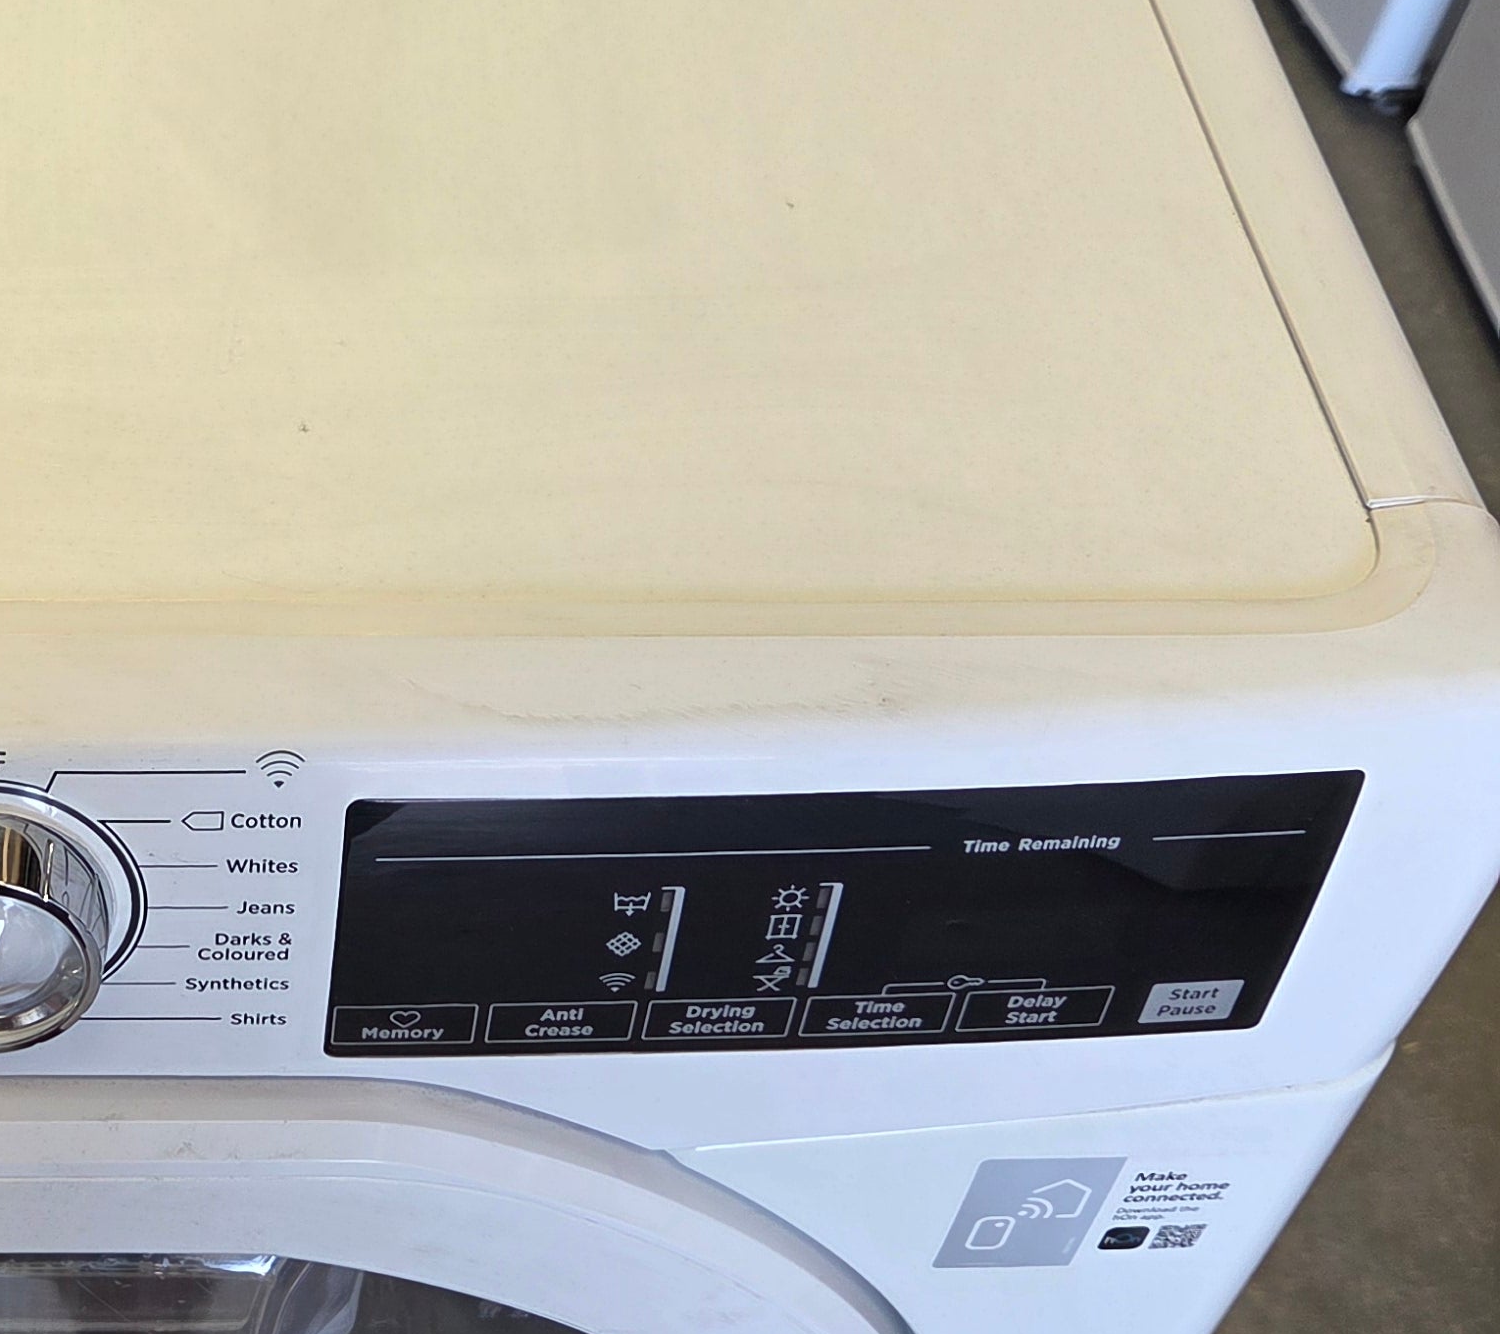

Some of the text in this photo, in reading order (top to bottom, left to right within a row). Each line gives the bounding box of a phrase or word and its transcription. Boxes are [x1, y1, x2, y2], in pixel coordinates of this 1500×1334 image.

[230, 813, 302, 829] Cotton
[963, 835, 1121, 853] Time Remaining
[226, 858, 299, 874] Whites
[236, 900, 296, 915] Jeans
[215, 932, 293, 946] Darks &
[198, 947, 290, 961] Coloured
[185, 977, 289, 992] Synthetics
[1168, 987, 1220, 1001] Start
[854, 1000, 906, 1014] Time
[1007, 994, 1068, 1009] Delay
[540, 1007, 584, 1021] Anti
[686, 1004, 756, 1021] Drying
[1005, 1010, 1057, 1024] Start
[1156, 1004, 1217, 1017] Pause
[230, 1012, 287, 1026] Shirts
[669, 1018, 765, 1034] Selection
[825, 1016, 923, 1031] Selection
[361, 1025, 444, 1041] Memory
[524, 1023, 594, 1037] Crease
[1134, 1171, 1188, 1182] Make
[1129, 1181, 1231, 1194] your home
